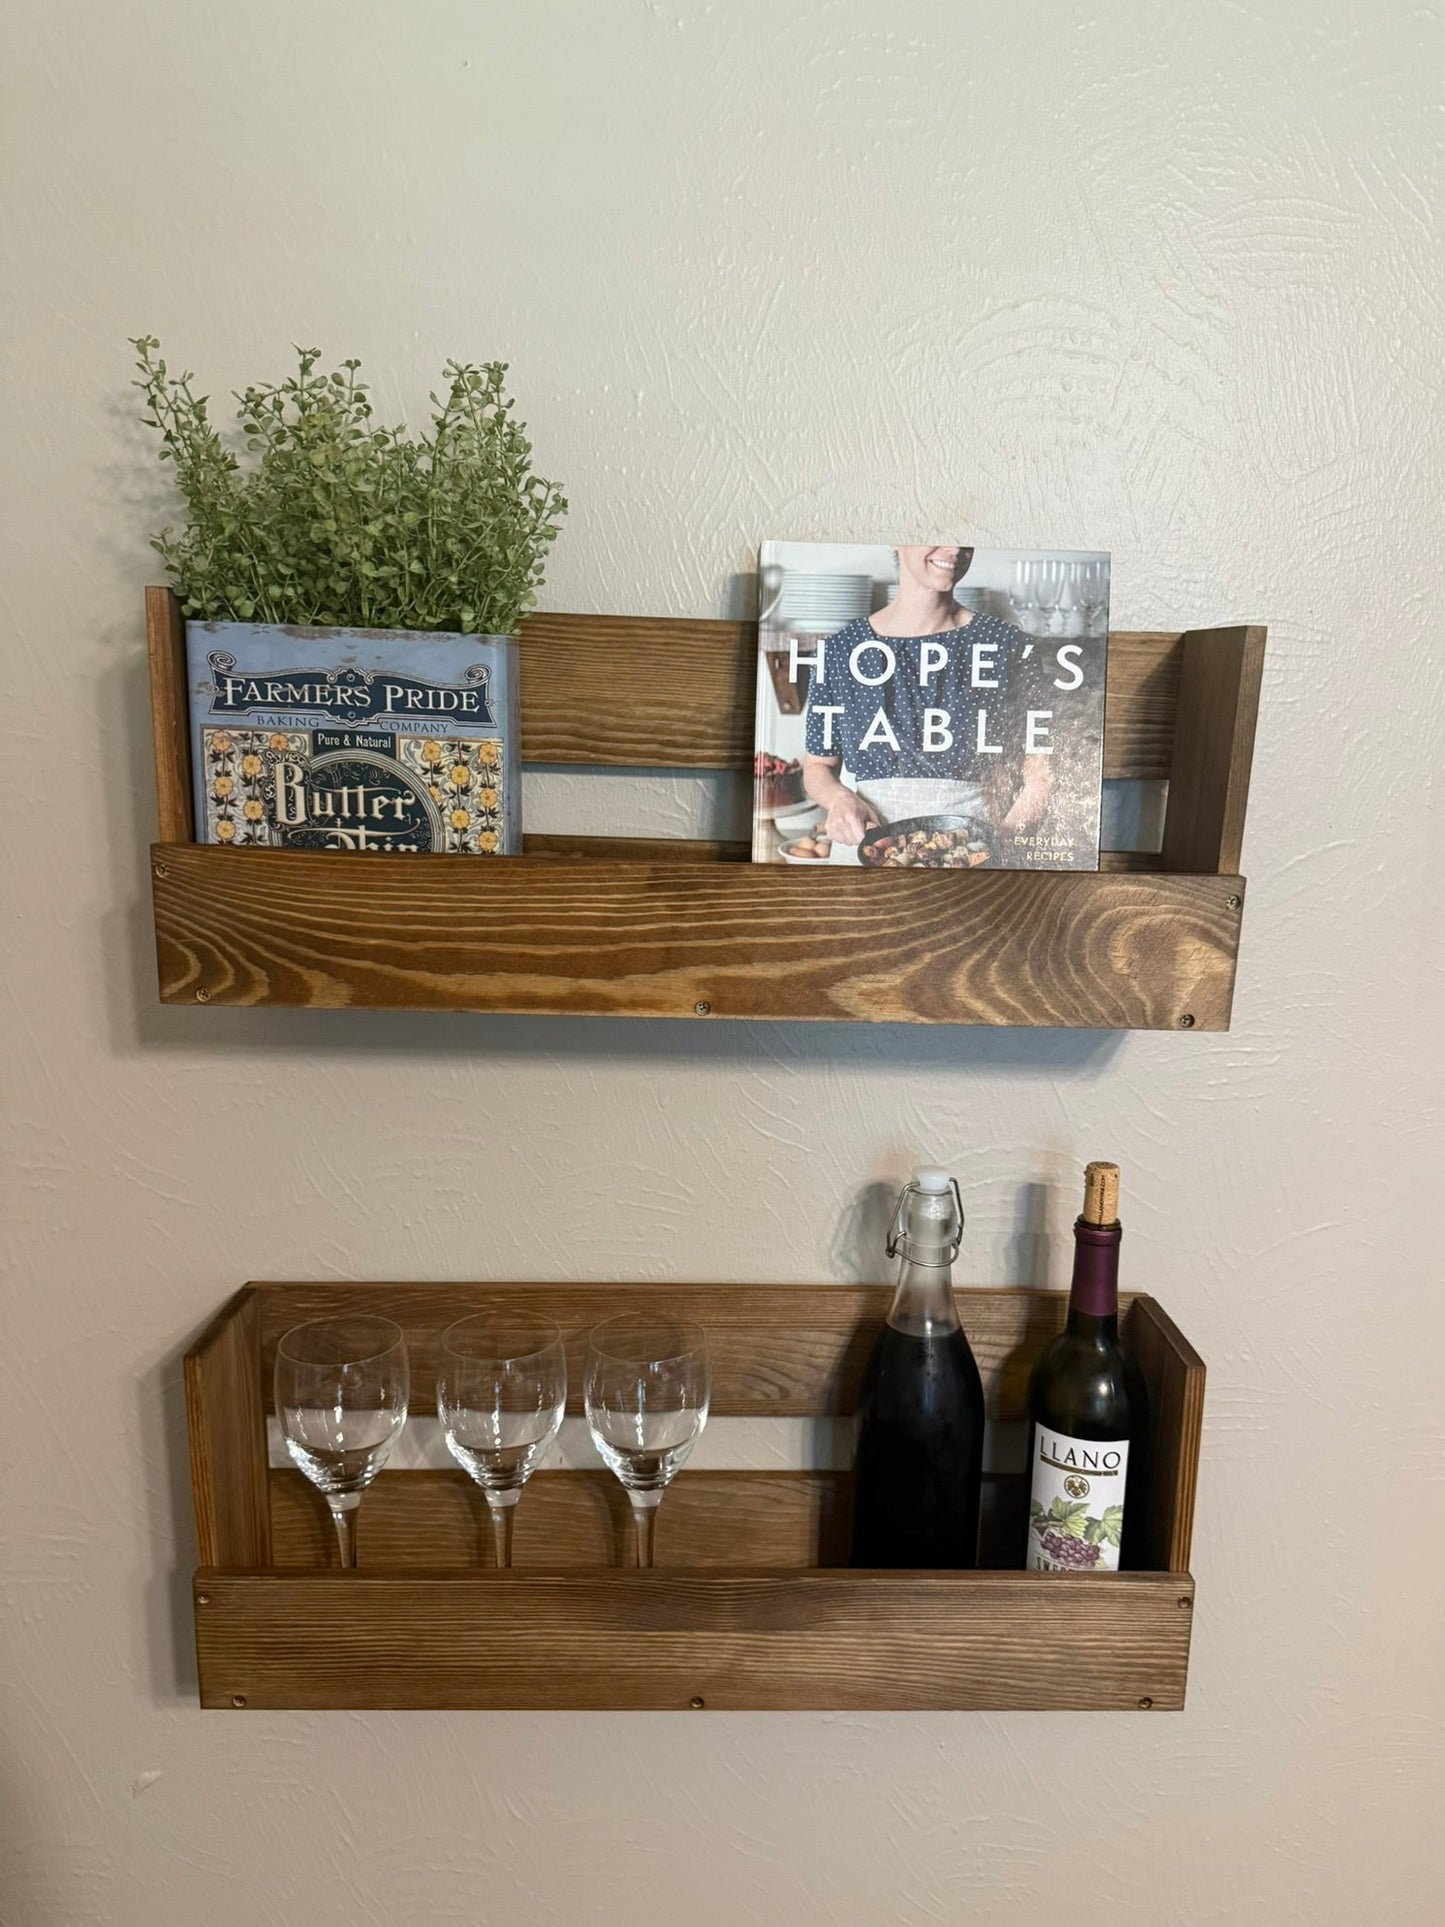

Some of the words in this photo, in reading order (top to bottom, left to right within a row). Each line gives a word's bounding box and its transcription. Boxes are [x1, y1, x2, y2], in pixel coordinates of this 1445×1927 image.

[788, 638, 1085, 691] HOPE'S
[383, 684, 480, 713] PRIDE
[257, 715, 320, 728] BAKING
[379, 720, 450, 734] COMPANY
[811, 705, 1055, 755] TABLE
[317, 732, 340, 746] Pure
[343, 734, 351, 747] &
[355, 734, 392, 749] Natural
[275, 761, 416, 826] Butter
[1013, 836, 1075, 847] EVERYDAY
[1026, 851, 1074, 862] RECIPES
[1040, 1435, 1121, 1470] LLANO
